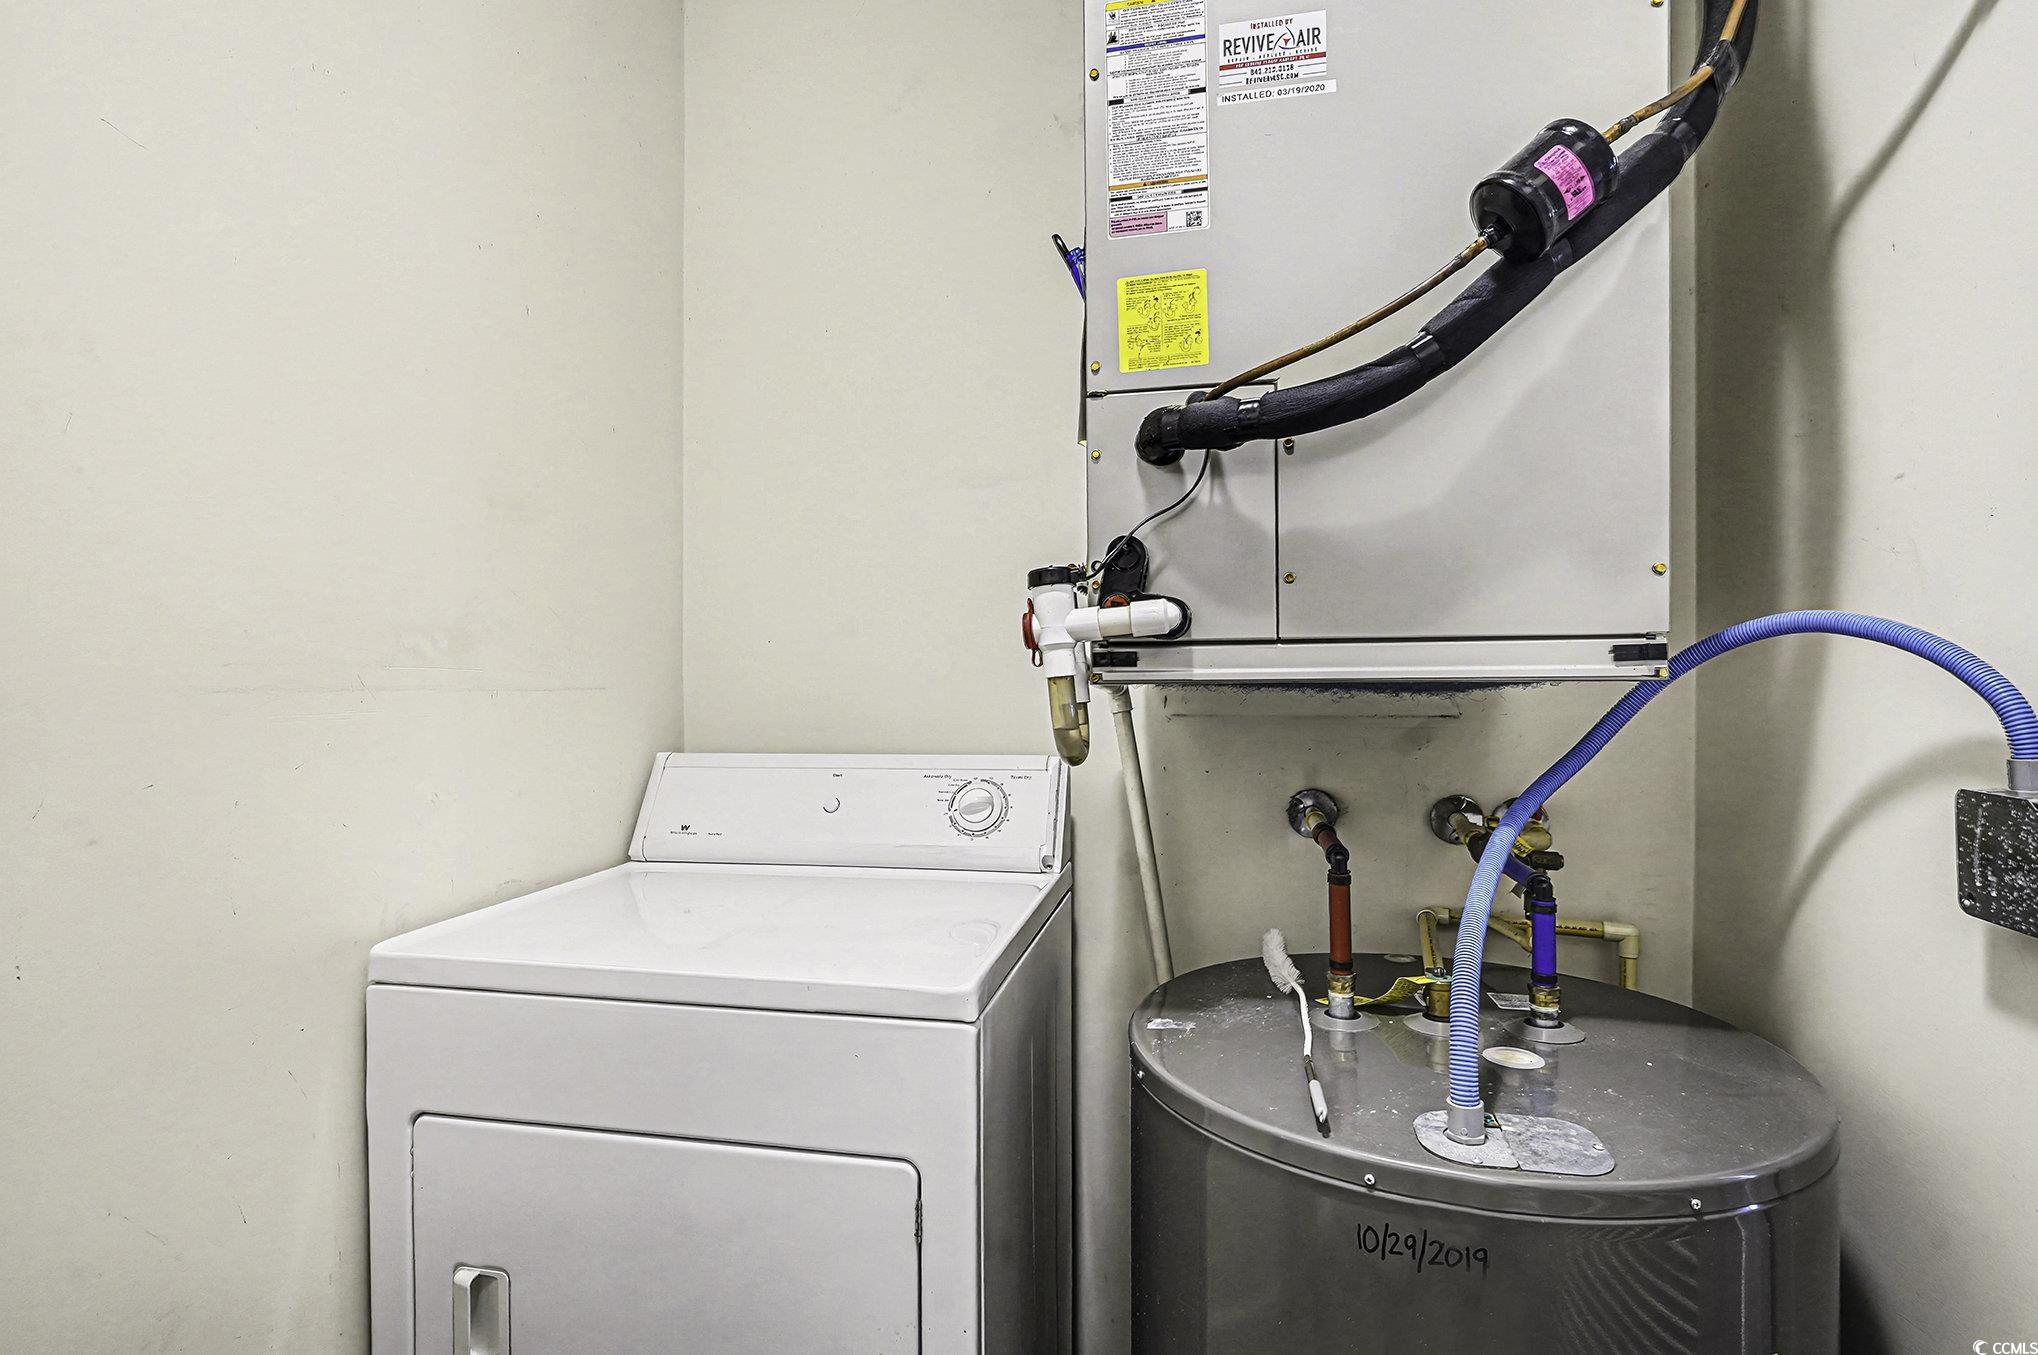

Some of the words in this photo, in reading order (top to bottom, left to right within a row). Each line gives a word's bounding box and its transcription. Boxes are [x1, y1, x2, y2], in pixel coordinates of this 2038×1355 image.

[1250, 19, 1283, 30] INSTALLED
[1223, 33, 1275, 57] REVIVE
[1296, 27, 1321, 47] AIR
[1221, 90, 1275, 103] INSTALLED:
[1277, 83, 1326, 97] 03/19/2020
[1357, 1223, 1489, 1280] 10/29/2019
